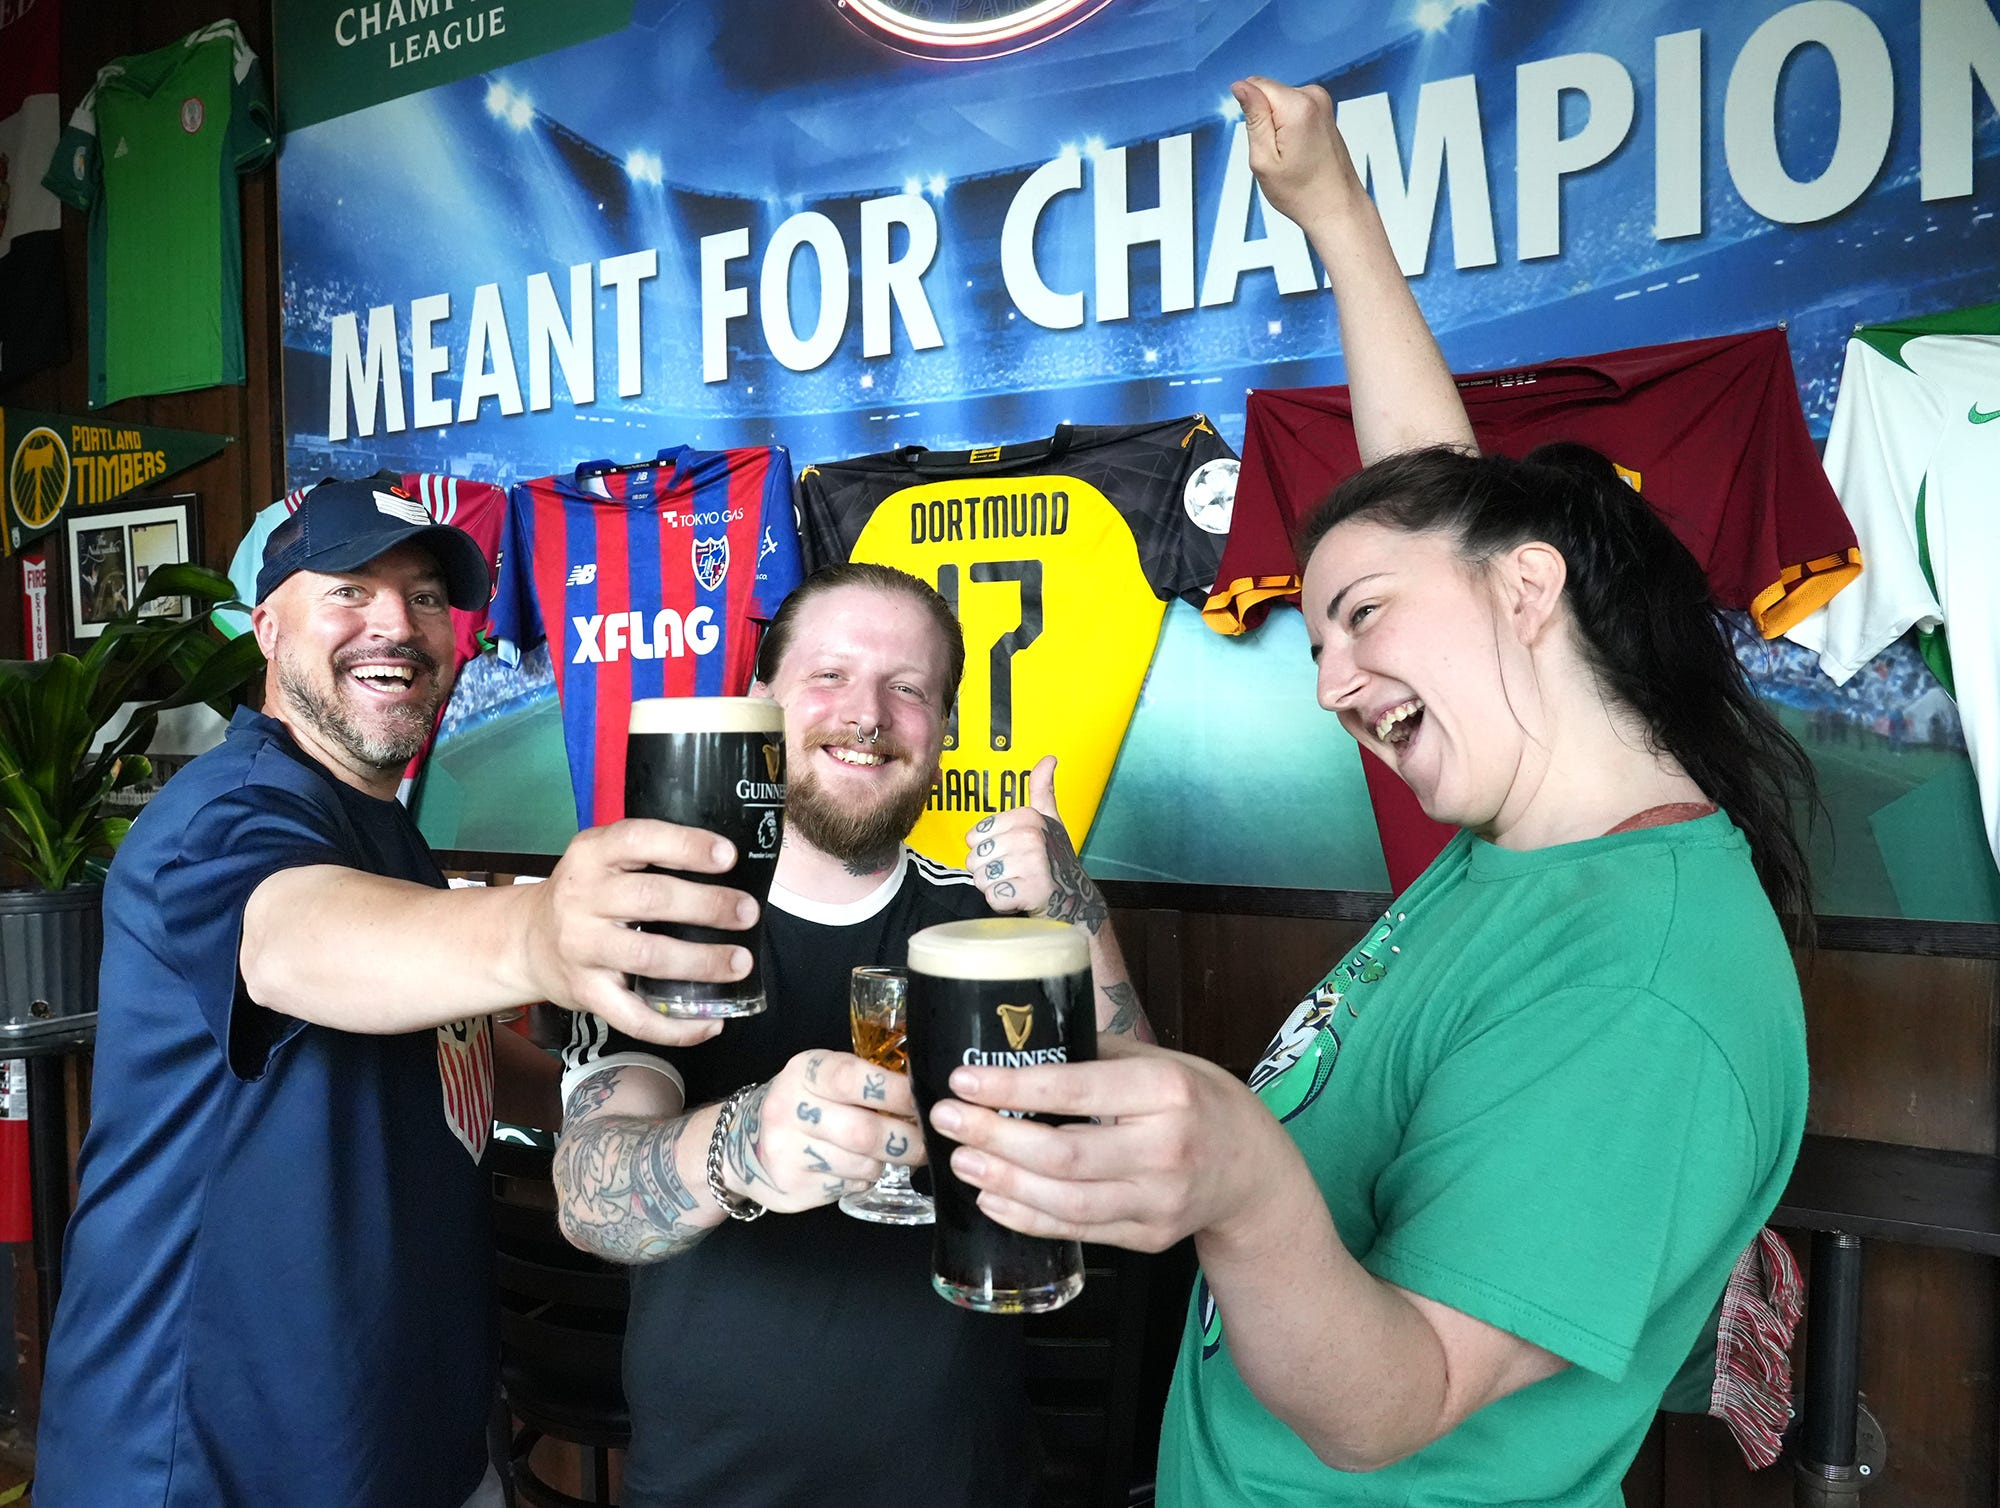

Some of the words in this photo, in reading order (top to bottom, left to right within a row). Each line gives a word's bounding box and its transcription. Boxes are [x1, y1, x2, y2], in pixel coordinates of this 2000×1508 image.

[389, 6, 506, 69] LEAGUE
[329, 248, 658, 442] MEANT
[700, 193, 945, 384] FOR
[72, 425, 142, 452] PORTLAND
[72, 451, 167, 506] TIMBERS
[680, 511, 720, 528] TOKYO
[721, 507, 744, 523] GAS
[911, 491, 1069, 545] DORTMUND
[27, 569, 47, 590] FIRE
[571, 605, 720, 665] XFLAG
[962, 1046, 1068, 1069] GUINNESS
